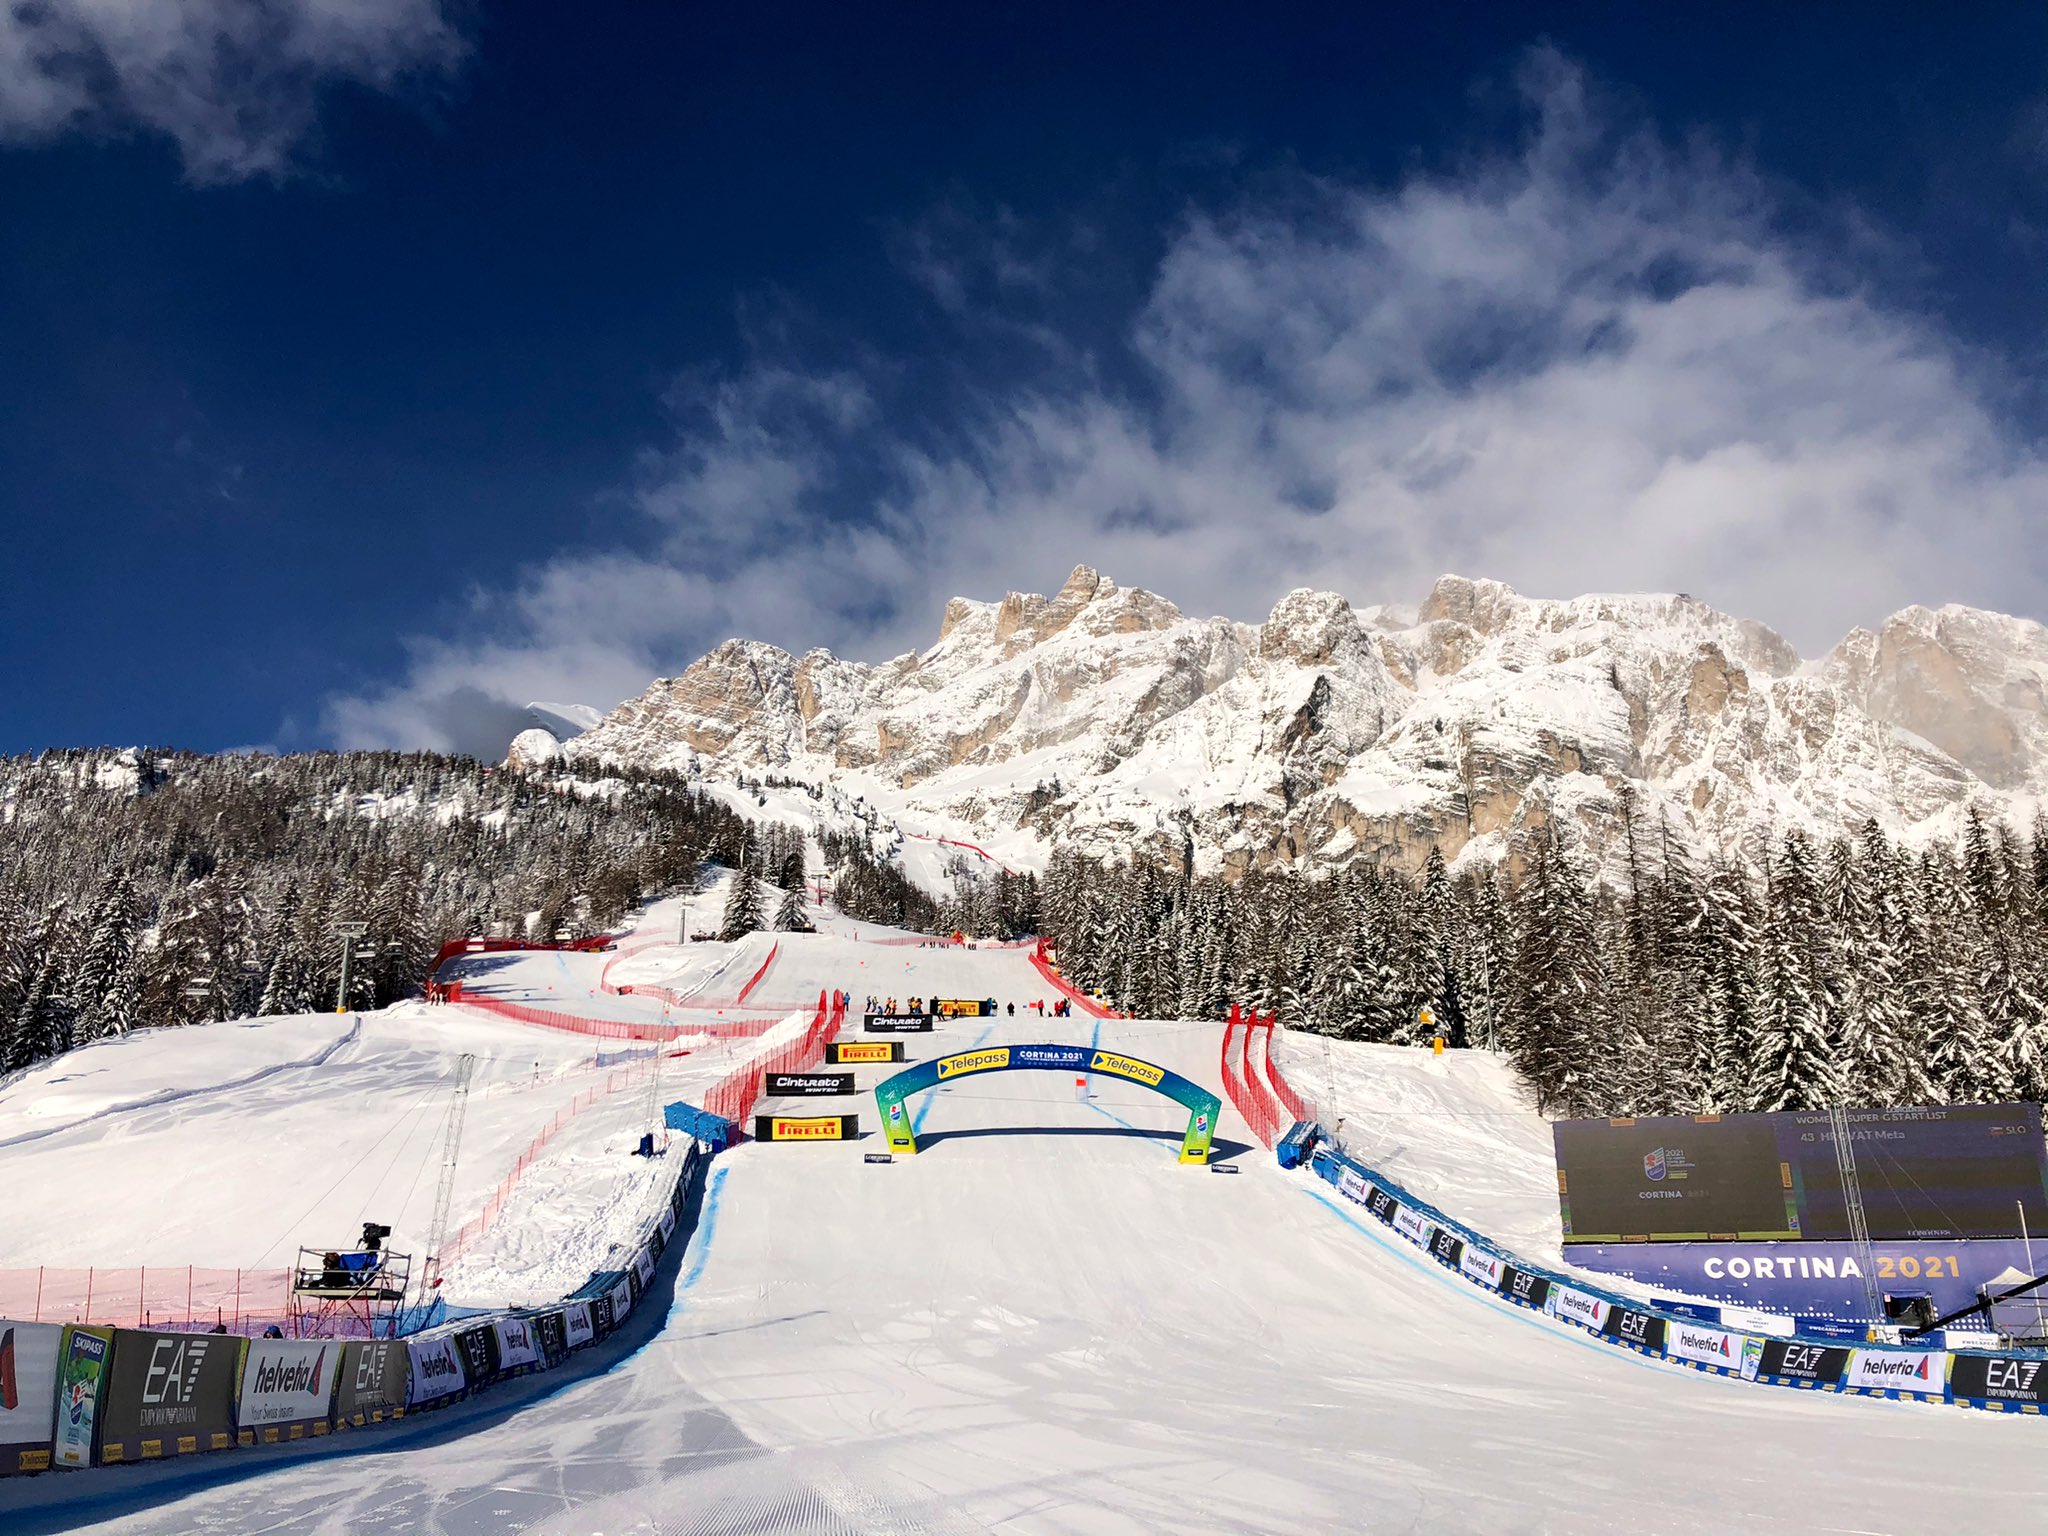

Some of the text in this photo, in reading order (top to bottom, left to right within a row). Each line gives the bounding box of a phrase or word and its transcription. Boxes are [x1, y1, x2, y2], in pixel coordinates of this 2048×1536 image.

[872, 1017, 922, 1026] Cinturato
[842, 1047, 887, 1058] PIRELLI
[950, 1053, 1007, 1070] Telepass
[1020, 1051, 1060, 1059] CORTINA
[1106, 1056, 1160, 1081] Telepass
[776, 1077, 840, 1087] Cinturato
[1848, 1114, 1880, 1123] SUPER
[1892, 1112, 1925, 1121] START
[1926, 1111, 1948, 1120] LIST
[778, 1122, 836, 1135] PIRELLI
[1800, 1132, 1815, 1142] 43
[1875, 1129, 1905, 1140] Meta
[1639, 1190, 1683, 1199] CORTINA
[1704, 1256, 1960, 1279] CORTINA 2021
[1513, 1272, 1535, 1293] EA7
[1562, 1293, 1592, 1314] helvetia
[1620, 1311, 1650, 1336] EA7
[74, 1336, 103, 1355] SKIPASS
[1680, 1332, 1718, 1353] helvetia
[356, 1344, 388, 1389] EA7
[1782, 1345, 1825, 1370] EA7
[1862, 1358, 1914, 1376] helvetia
[143, 1339, 209, 1402] EA7
[253, 1356, 310, 1394] helvetia
[1986, 1360, 2041, 1389] EA7
